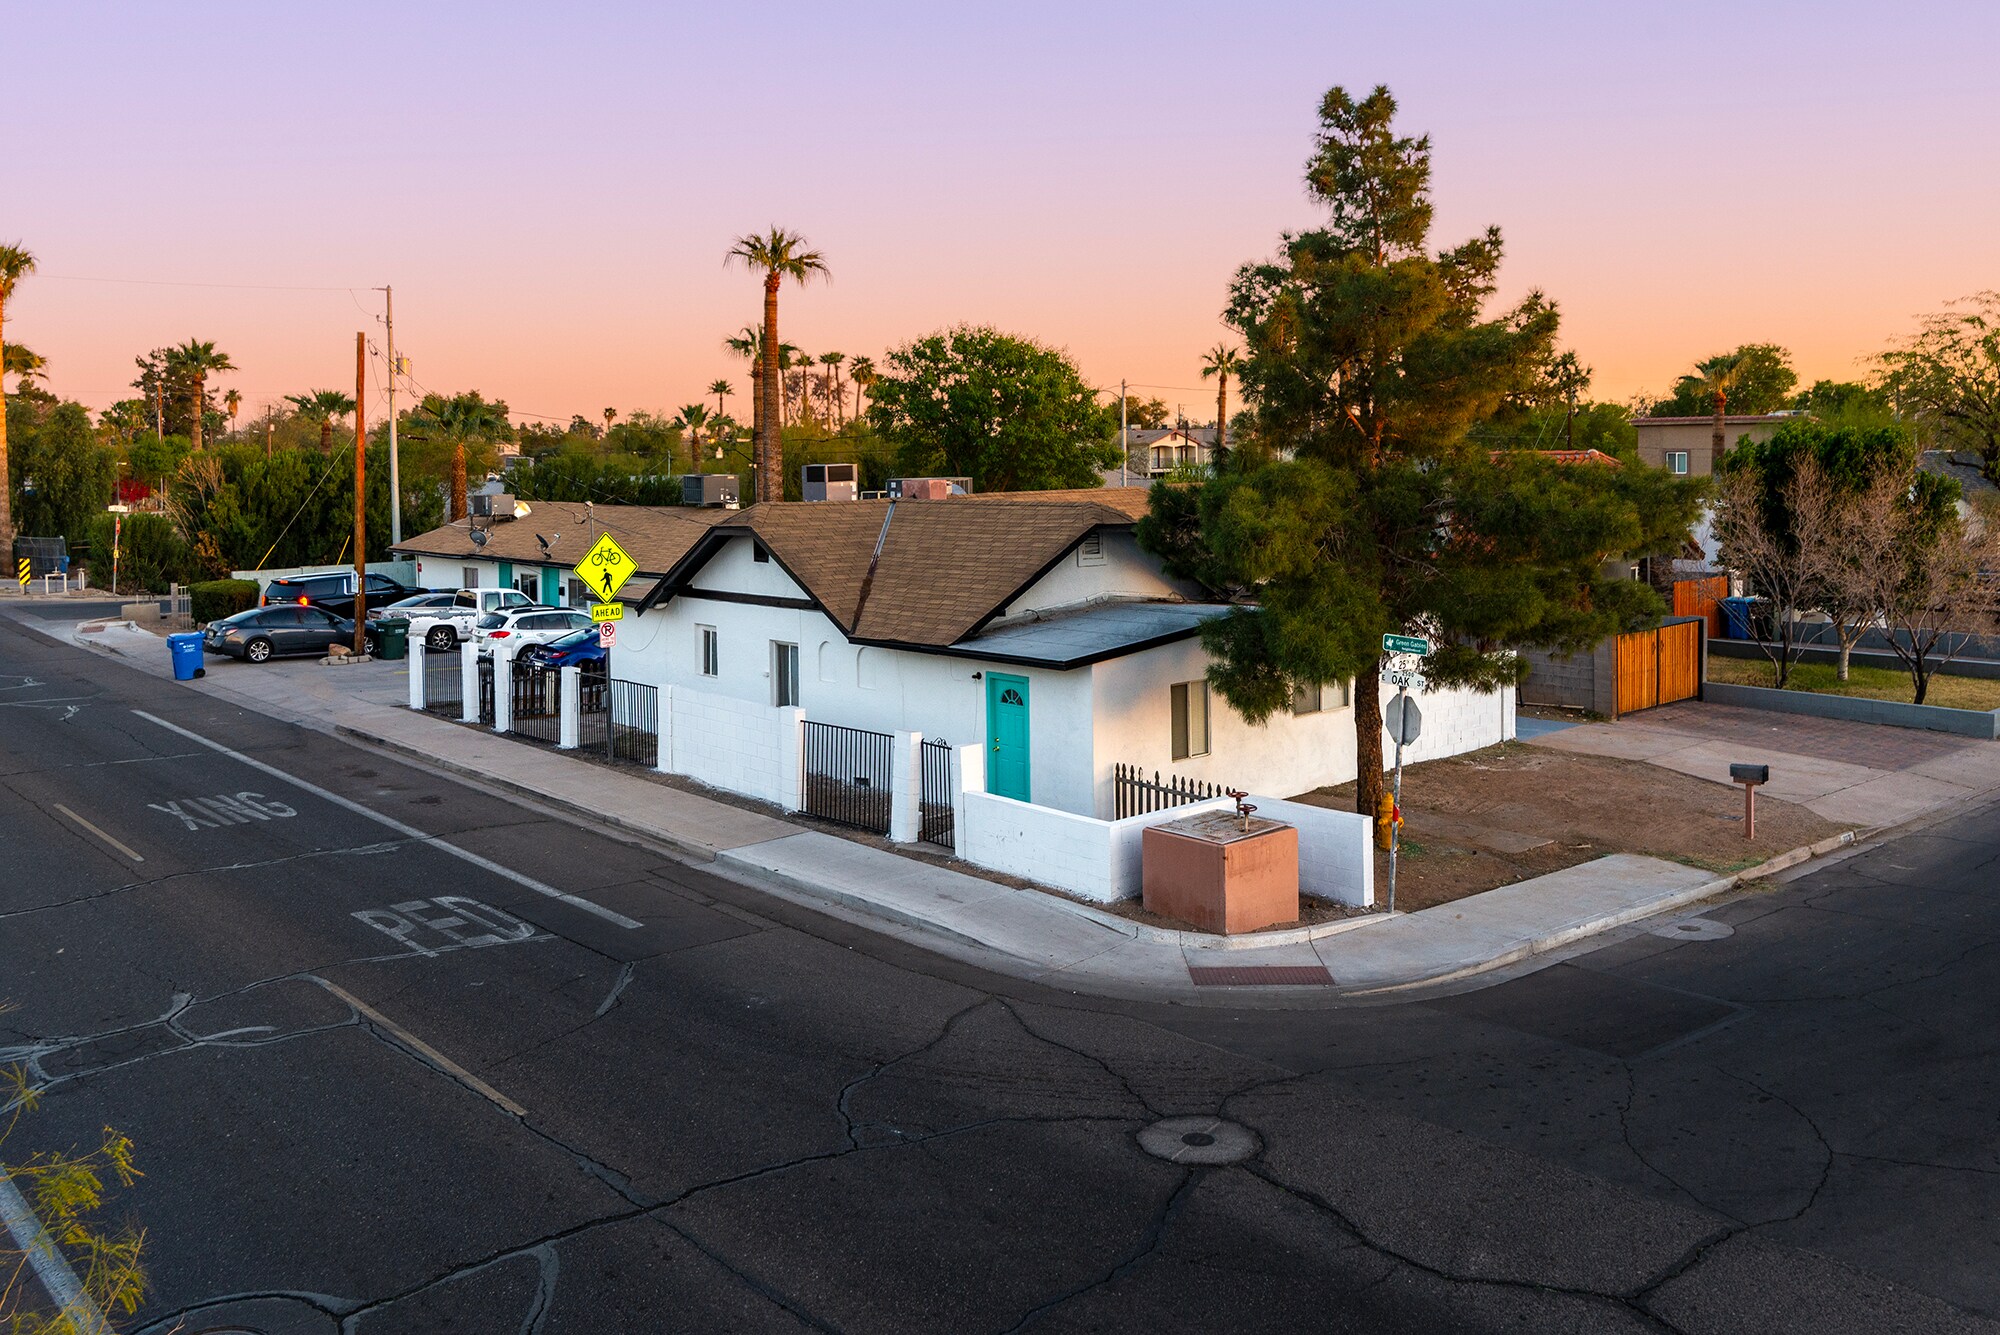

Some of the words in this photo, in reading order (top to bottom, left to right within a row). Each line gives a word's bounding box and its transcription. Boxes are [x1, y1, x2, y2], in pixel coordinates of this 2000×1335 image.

[595, 608, 620, 618] AHEAD
[1395, 639, 1409, 647] Green
[1410, 641, 1427, 649] Gables
[1391, 675, 1410, 687] OAK
[148, 792, 297, 830] XING
[351, 897, 535, 957] PED
